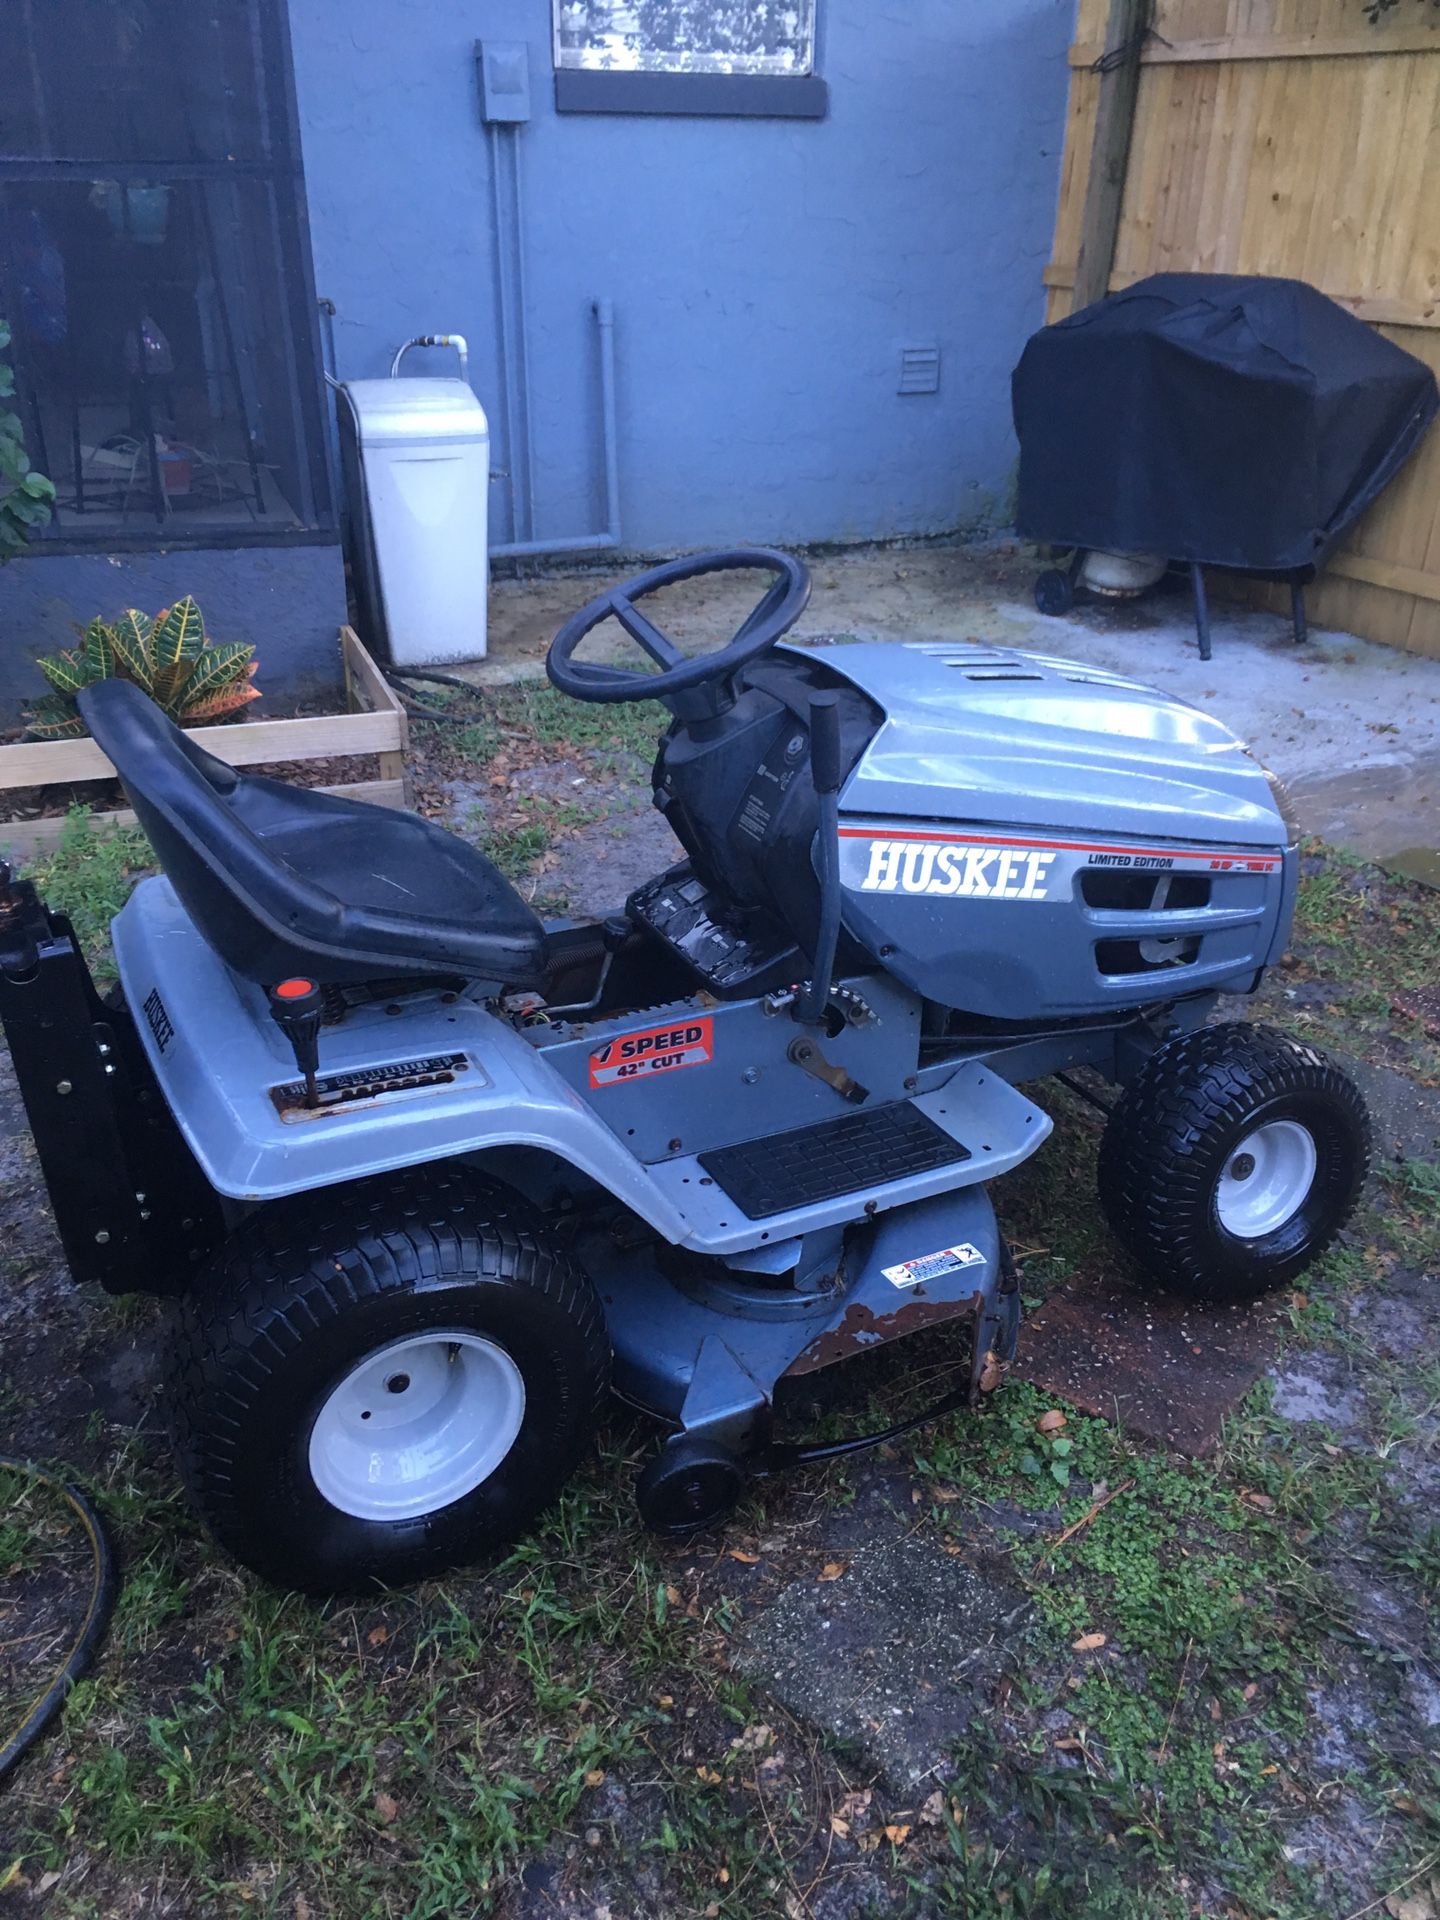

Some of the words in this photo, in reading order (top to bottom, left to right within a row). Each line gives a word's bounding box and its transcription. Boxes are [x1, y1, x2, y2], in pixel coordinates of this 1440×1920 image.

[861, 841, 1057, 899] HUSKEE
[1088, 854, 1131, 866] LIMITED
[1133, 857, 1174, 868] EDITION
[143, 987, 174, 1054] HUSKEE
[621, 1026, 702, 1058] SPEED
[617, 1062, 645, 1077] 42"
[652, 1052, 685, 1069] CUT
